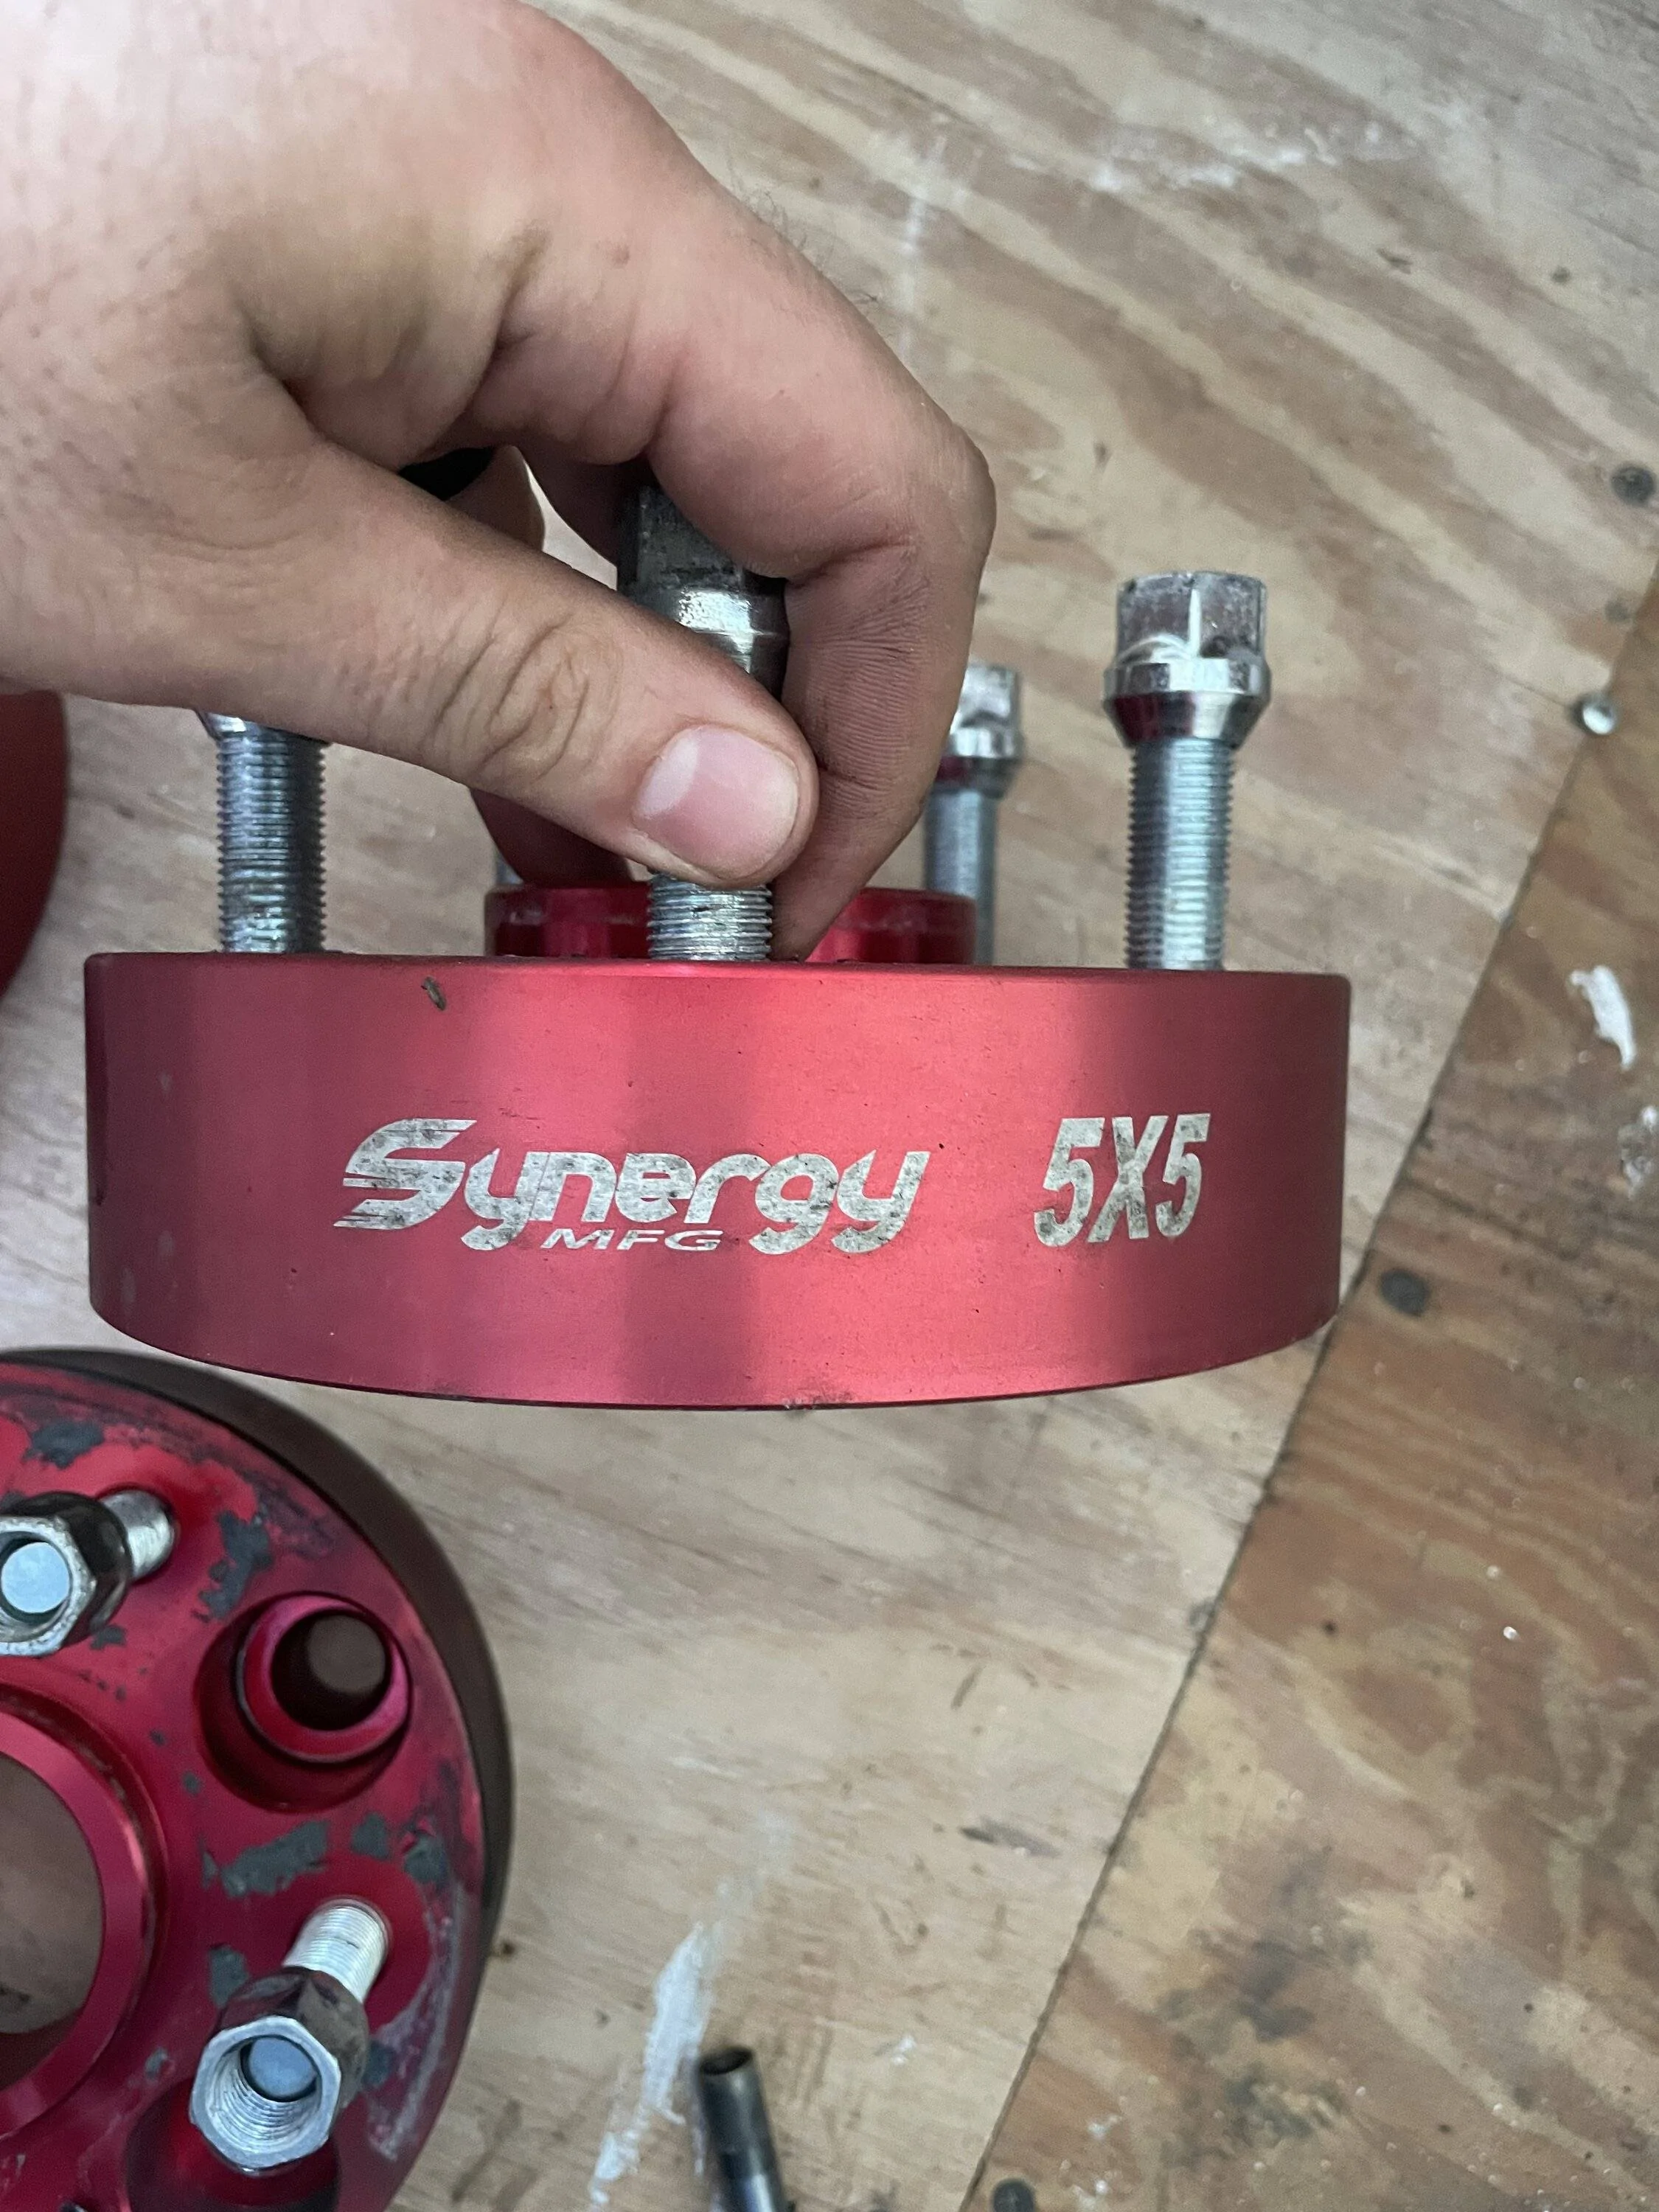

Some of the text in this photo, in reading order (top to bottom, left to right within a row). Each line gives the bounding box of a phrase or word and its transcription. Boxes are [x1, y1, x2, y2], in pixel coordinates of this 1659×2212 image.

[333, 1118, 931, 1255] Synergy
[540, 1228, 724, 1252] MFG
[1034, 1113, 1211, 1247] 5X5
